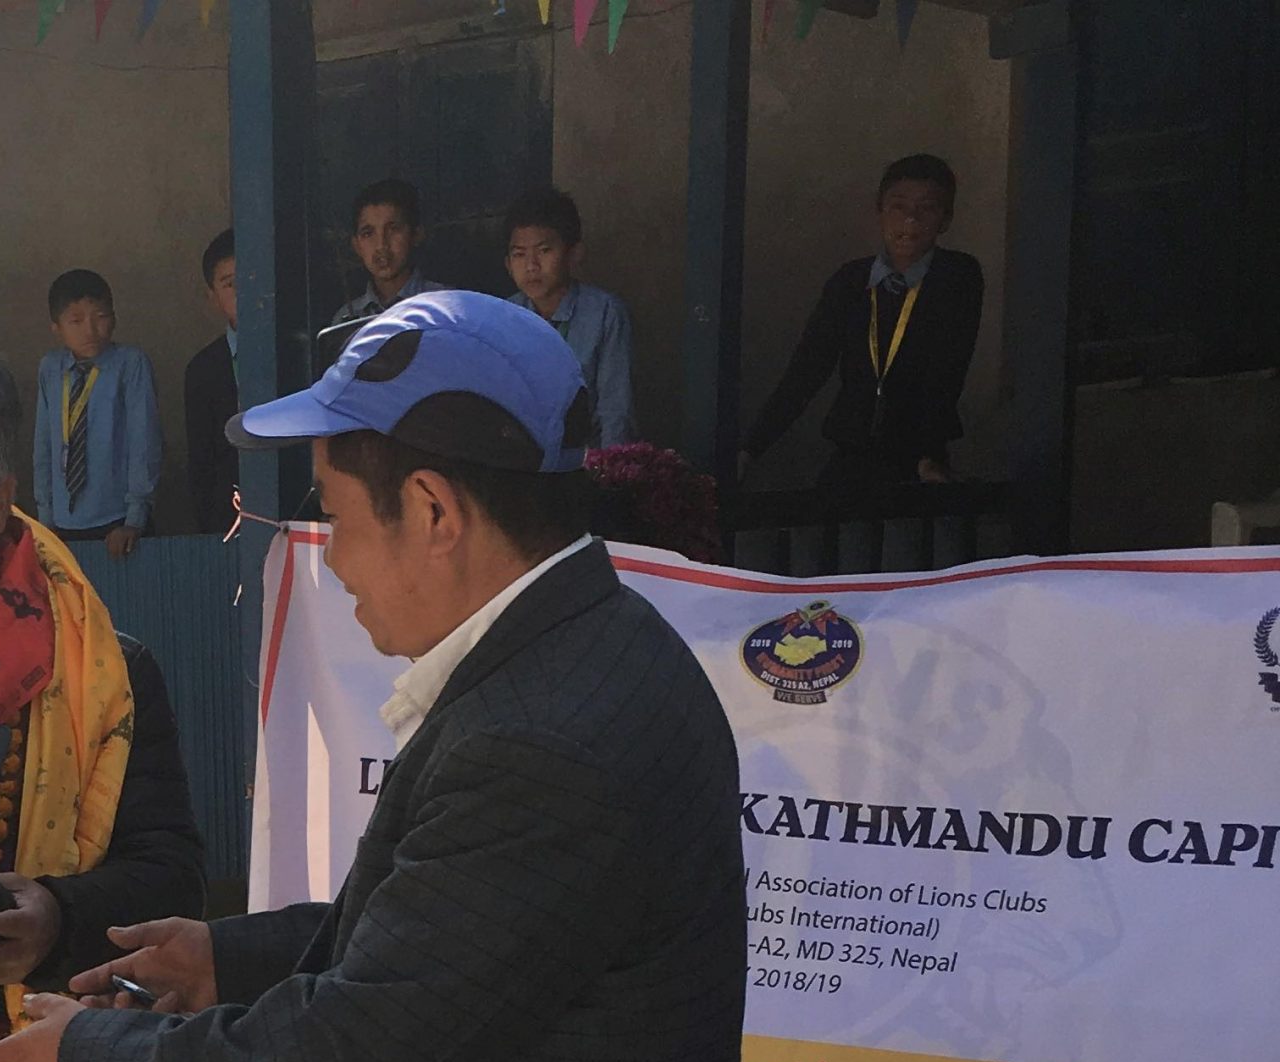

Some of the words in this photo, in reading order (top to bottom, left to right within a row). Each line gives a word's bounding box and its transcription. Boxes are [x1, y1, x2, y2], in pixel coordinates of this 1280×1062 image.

[750, 638, 771, 648] 2018
[831, 639, 853, 649] 2019
[760, 670, 781, 686] DIST.
[812, 672, 840, 689] NEPAL
[739, 792, 1113, 860] KATHMANDU
[1127, 818, 1280, 869] CAPI
[755, 870, 883, 902] Association
[889, 883, 916, 904] of
[917, 885, 978, 909] Lions
[983, 889, 1048, 913] Clubs
[790, 906, 940, 941] International)
[748, 936, 791, 961] -A2,
[796, 940, 835, 962] MD
[838, 943, 884, 969] 325,
[890, 948, 959, 976] Nepal
[753, 968, 842, 994] 2018/19
